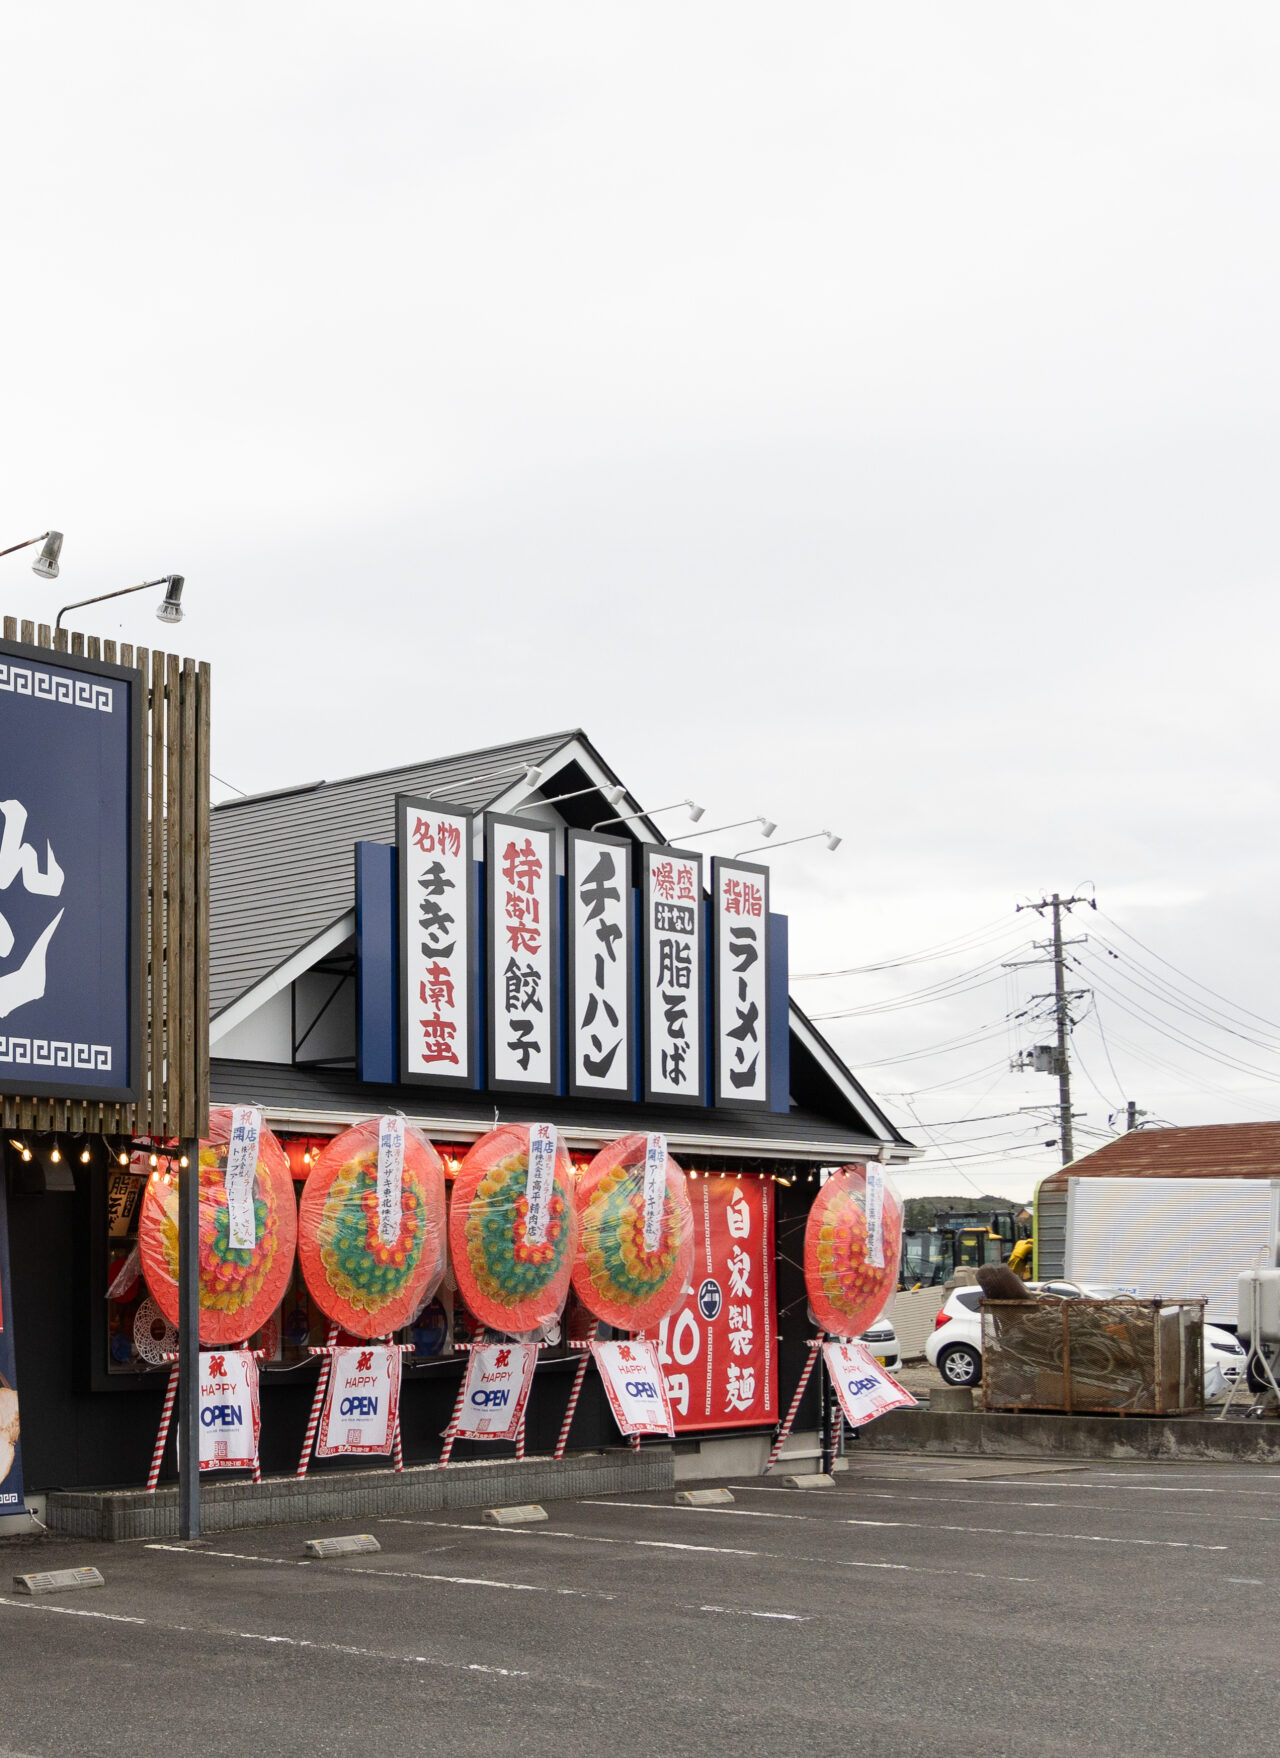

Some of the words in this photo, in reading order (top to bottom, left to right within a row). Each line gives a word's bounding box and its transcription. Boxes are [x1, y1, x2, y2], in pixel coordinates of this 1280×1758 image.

[412, 816, 461, 858] 名物
[651, 861, 697, 903] 爆盛
[723, 877, 762, 919] 背脂
[656, 904, 693, 932] 汁なし
[417, 860, 460, 1066] チキン南蛮
[502, 837, 544, 1072] 特製餃子
[579, 851, 624, 1079] チャーハン
[656, 938, 692, 1087] 脂そば
[725, 926, 760, 1090] ラーメン
[240, 1109, 253, 1126] 祝
[386, 1118, 398, 1133] 祝
[232, 1127, 258, 1143] 開店
[381, 1134, 402, 1149] 開店
[538, 1125, 550, 1140] 祝
[531, 1140, 554, 1154] 開店
[724, 1186, 756, 1414] 自家製麺
[208, 1354, 228, 1379] 祝
[355, 1351, 374, 1373] 祝
[494, 1348, 512, 1369] 祝
[481, 1371, 514, 1383] HAPPY
[617, 1364, 648, 1375] HAPPY
[201, 1383, 237, 1397] HAPPY
[344, 1376, 378, 1389] HAPPY
[625, 1381, 659, 1400] OPEN
[848, 1374, 883, 1396] OPEN
[340, 1396, 378, 1416] OPEN
[471, 1388, 511, 1408] OPEN
[200, 1404, 243, 1428] OPEN
